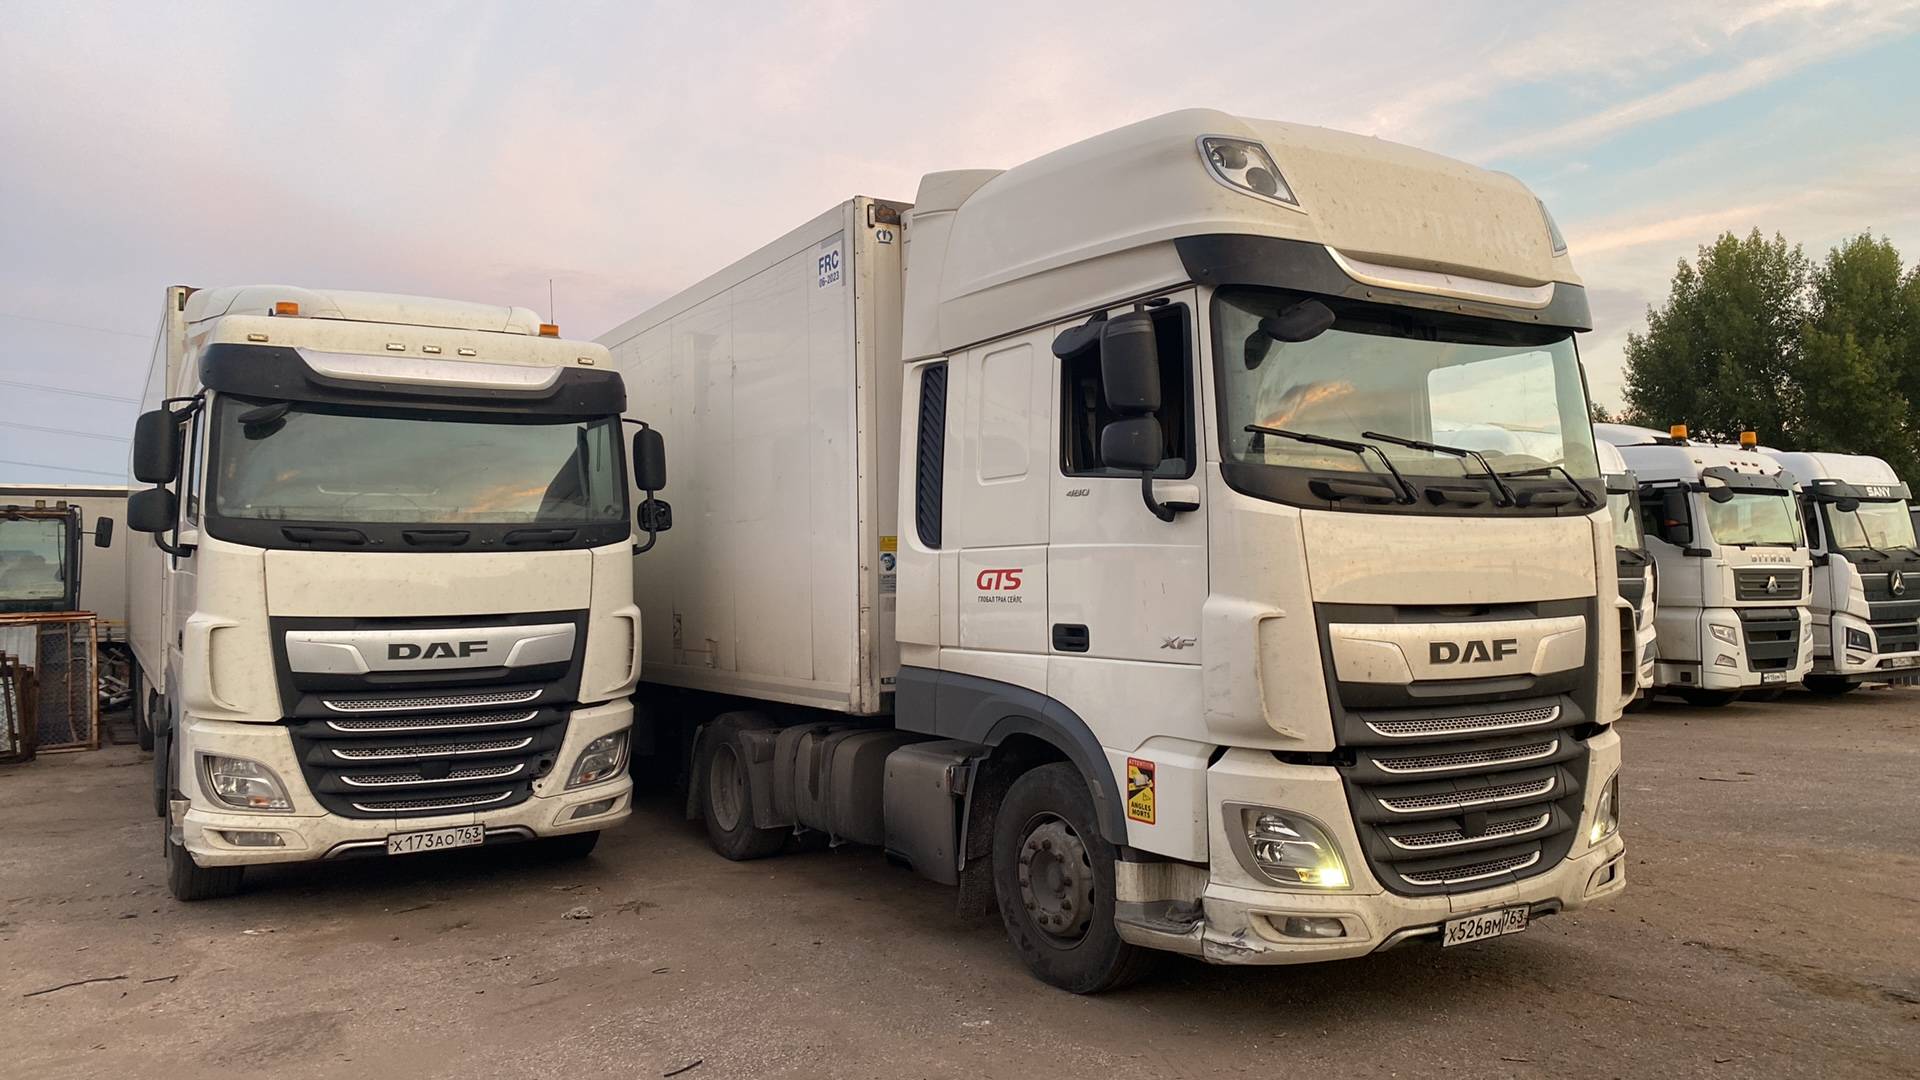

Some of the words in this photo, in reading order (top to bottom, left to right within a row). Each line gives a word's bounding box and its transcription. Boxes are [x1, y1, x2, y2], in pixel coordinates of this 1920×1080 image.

[818, 250, 839, 276] FRC
[818, 270, 840, 288] 06-2023
[1066, 489, 1090, 497] 480
[1866, 486, 1891, 497] SANY
[976, 568, 1023, 590] GTS
[388, 640, 488, 660] DAF
[1160, 636, 1198, 650] XF
[1429, 638, 1517, 665] DAF
[1131, 801, 1152, 811] ANGLES
[1131, 808, 1151, 818] MORTS
